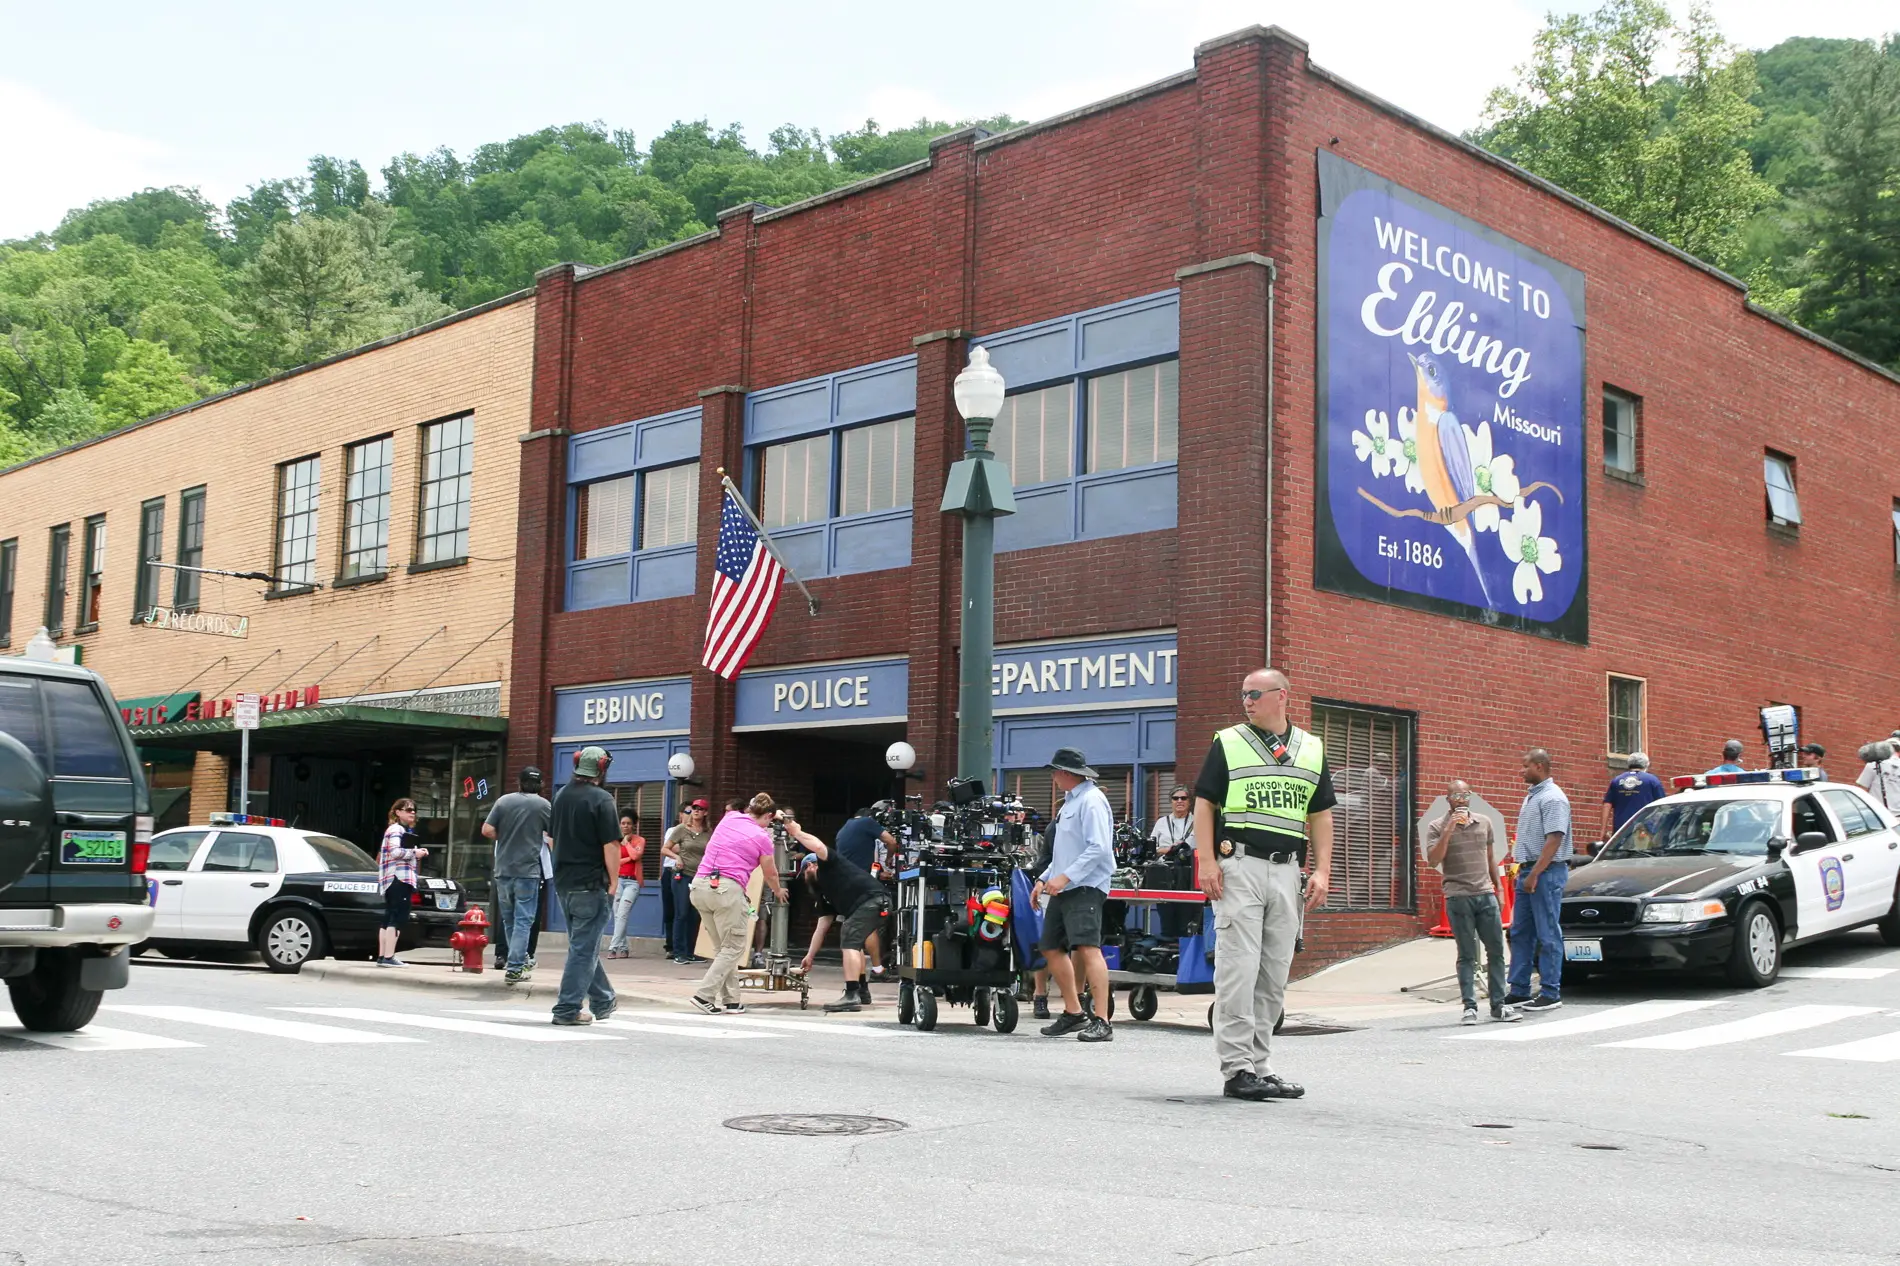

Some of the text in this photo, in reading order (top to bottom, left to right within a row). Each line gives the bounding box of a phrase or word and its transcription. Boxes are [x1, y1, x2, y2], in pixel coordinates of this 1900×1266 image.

[1374, 216, 1550, 320] WELCOME TO
[1361, 262, 1532, 399] Ebbing
[1493, 401, 1562, 446] Missouri
[1404, 539, 1443, 569] 1886
[171, 611, 229, 634] RECORDS
[992, 649, 1178, 696] EPARTMENT
[121, 705, 168, 726] USIC
[186, 684, 320, 722] EMPRIUM
[583, 692, 664, 725] EBBING
[774, 675, 870, 712] POLICE
[1245, 781, 1282, 792] JACKSON
[327, 882, 376, 892] POLICE 911
[1737, 880, 1757, 896] UNIT
